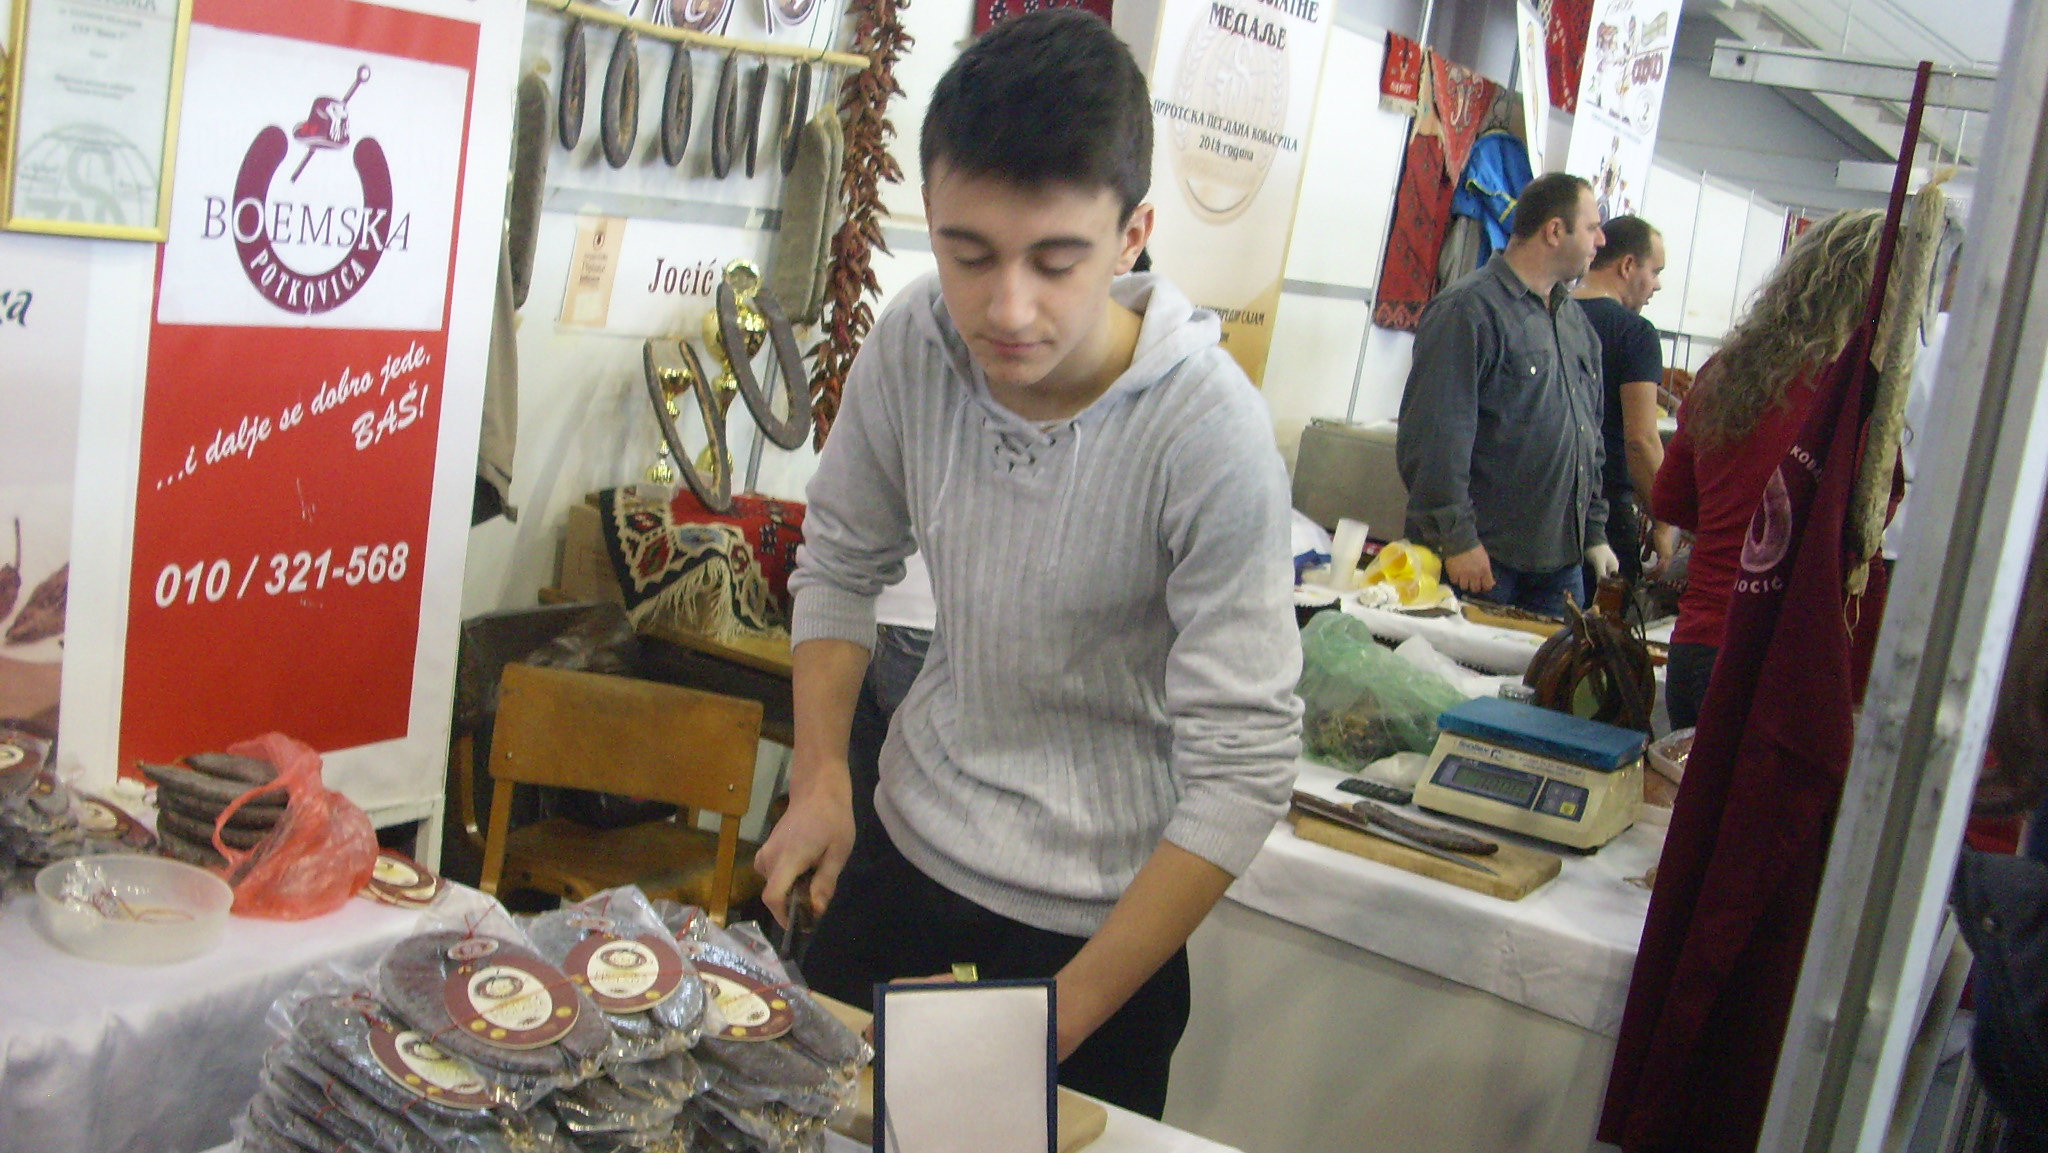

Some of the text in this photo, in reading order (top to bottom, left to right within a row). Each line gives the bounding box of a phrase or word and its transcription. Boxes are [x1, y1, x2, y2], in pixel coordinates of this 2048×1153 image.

[1209, 2, 1287, 50] МЕДАЉЕ
[201, 196, 411, 252] BOEMSKA
[250, 249, 366, 307] POTKOVICA
[647, 256, 718, 297] Jocić
[205, 415, 272, 460] dalje
[279, 402, 305, 432] se
[311, 367, 374, 416] dobro
[351, 380, 430, 451] BAŠ!
[155, 557, 231, 609] 010
[265, 541, 410, 596] 321-568
